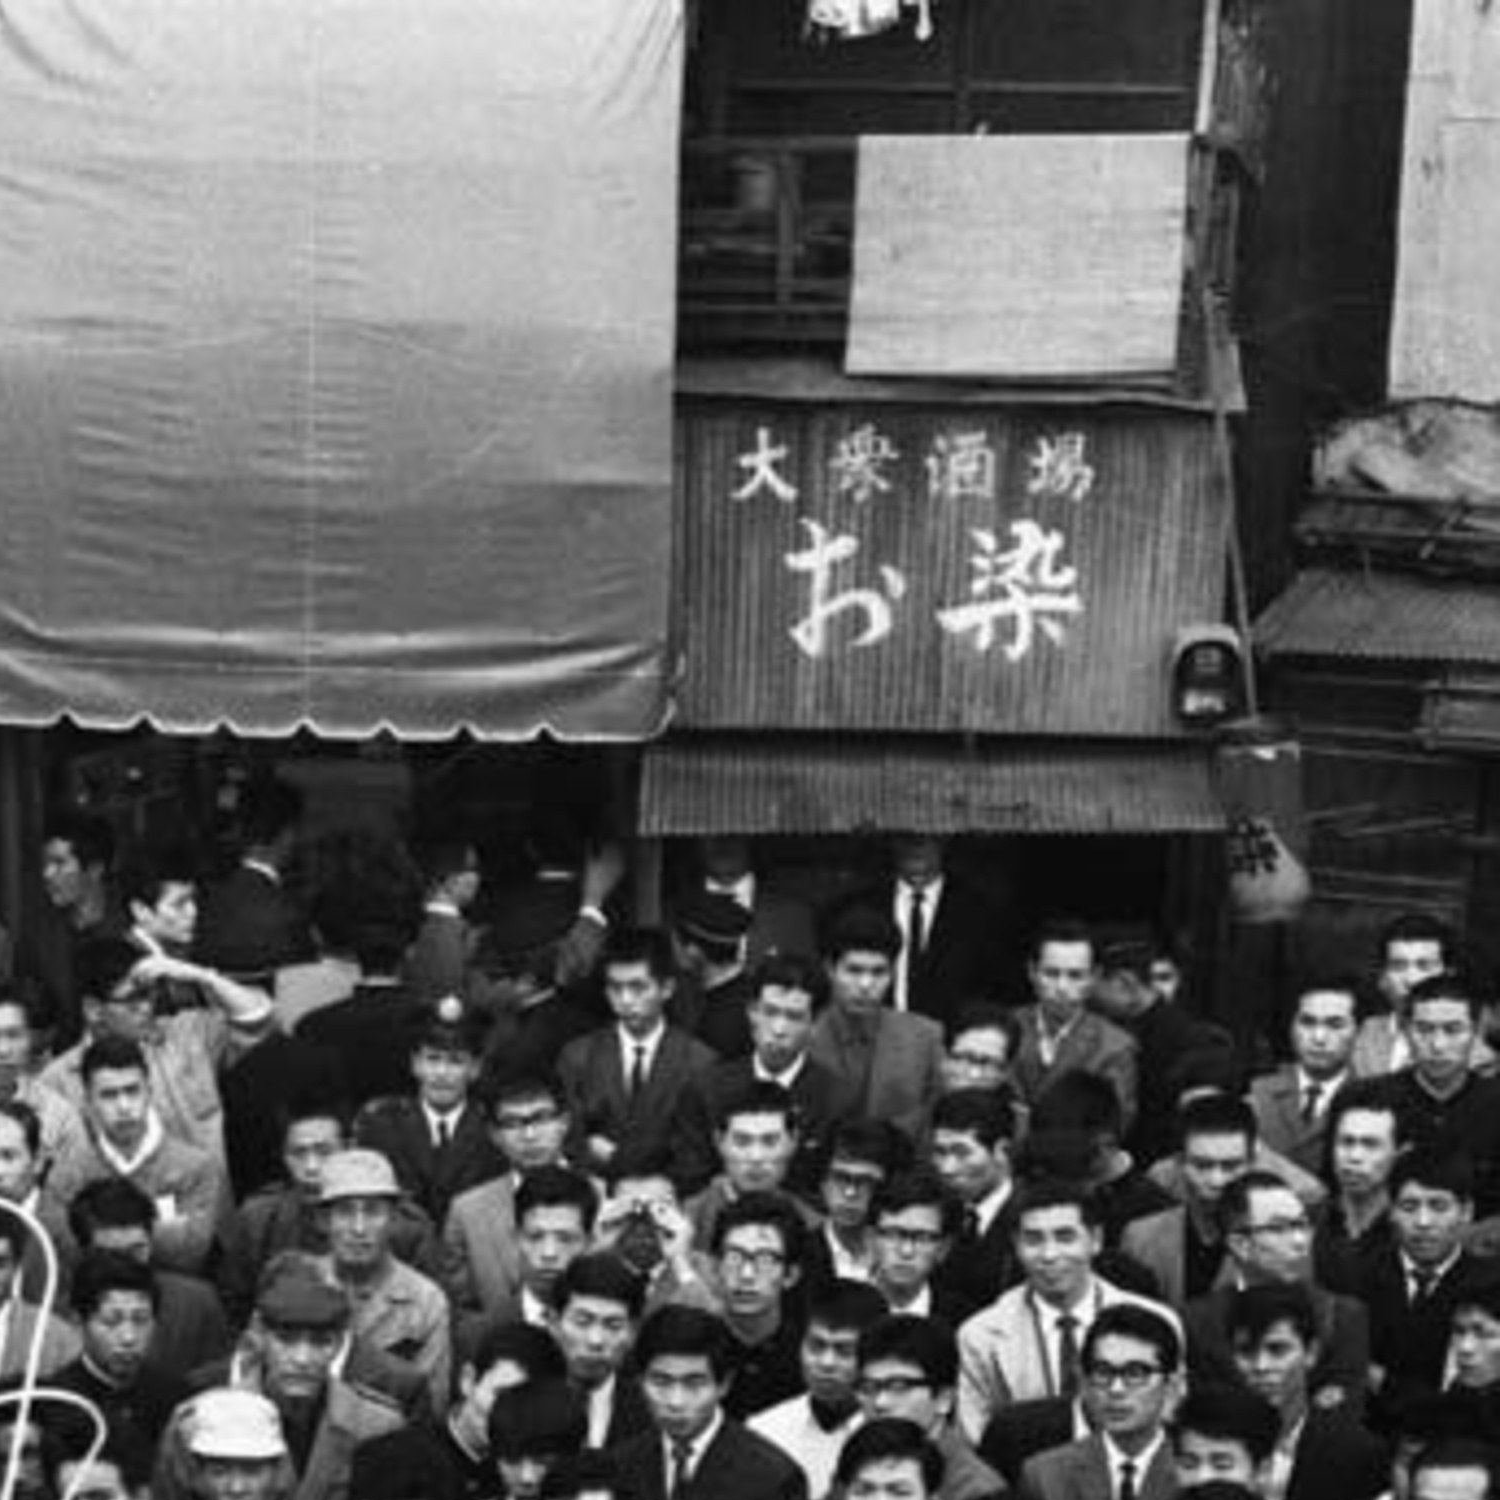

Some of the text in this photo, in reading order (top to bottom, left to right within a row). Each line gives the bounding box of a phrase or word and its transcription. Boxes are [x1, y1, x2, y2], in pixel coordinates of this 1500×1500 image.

[729, 422, 1095, 502] 大衆酒場
[784, 517, 1086, 661] お染
